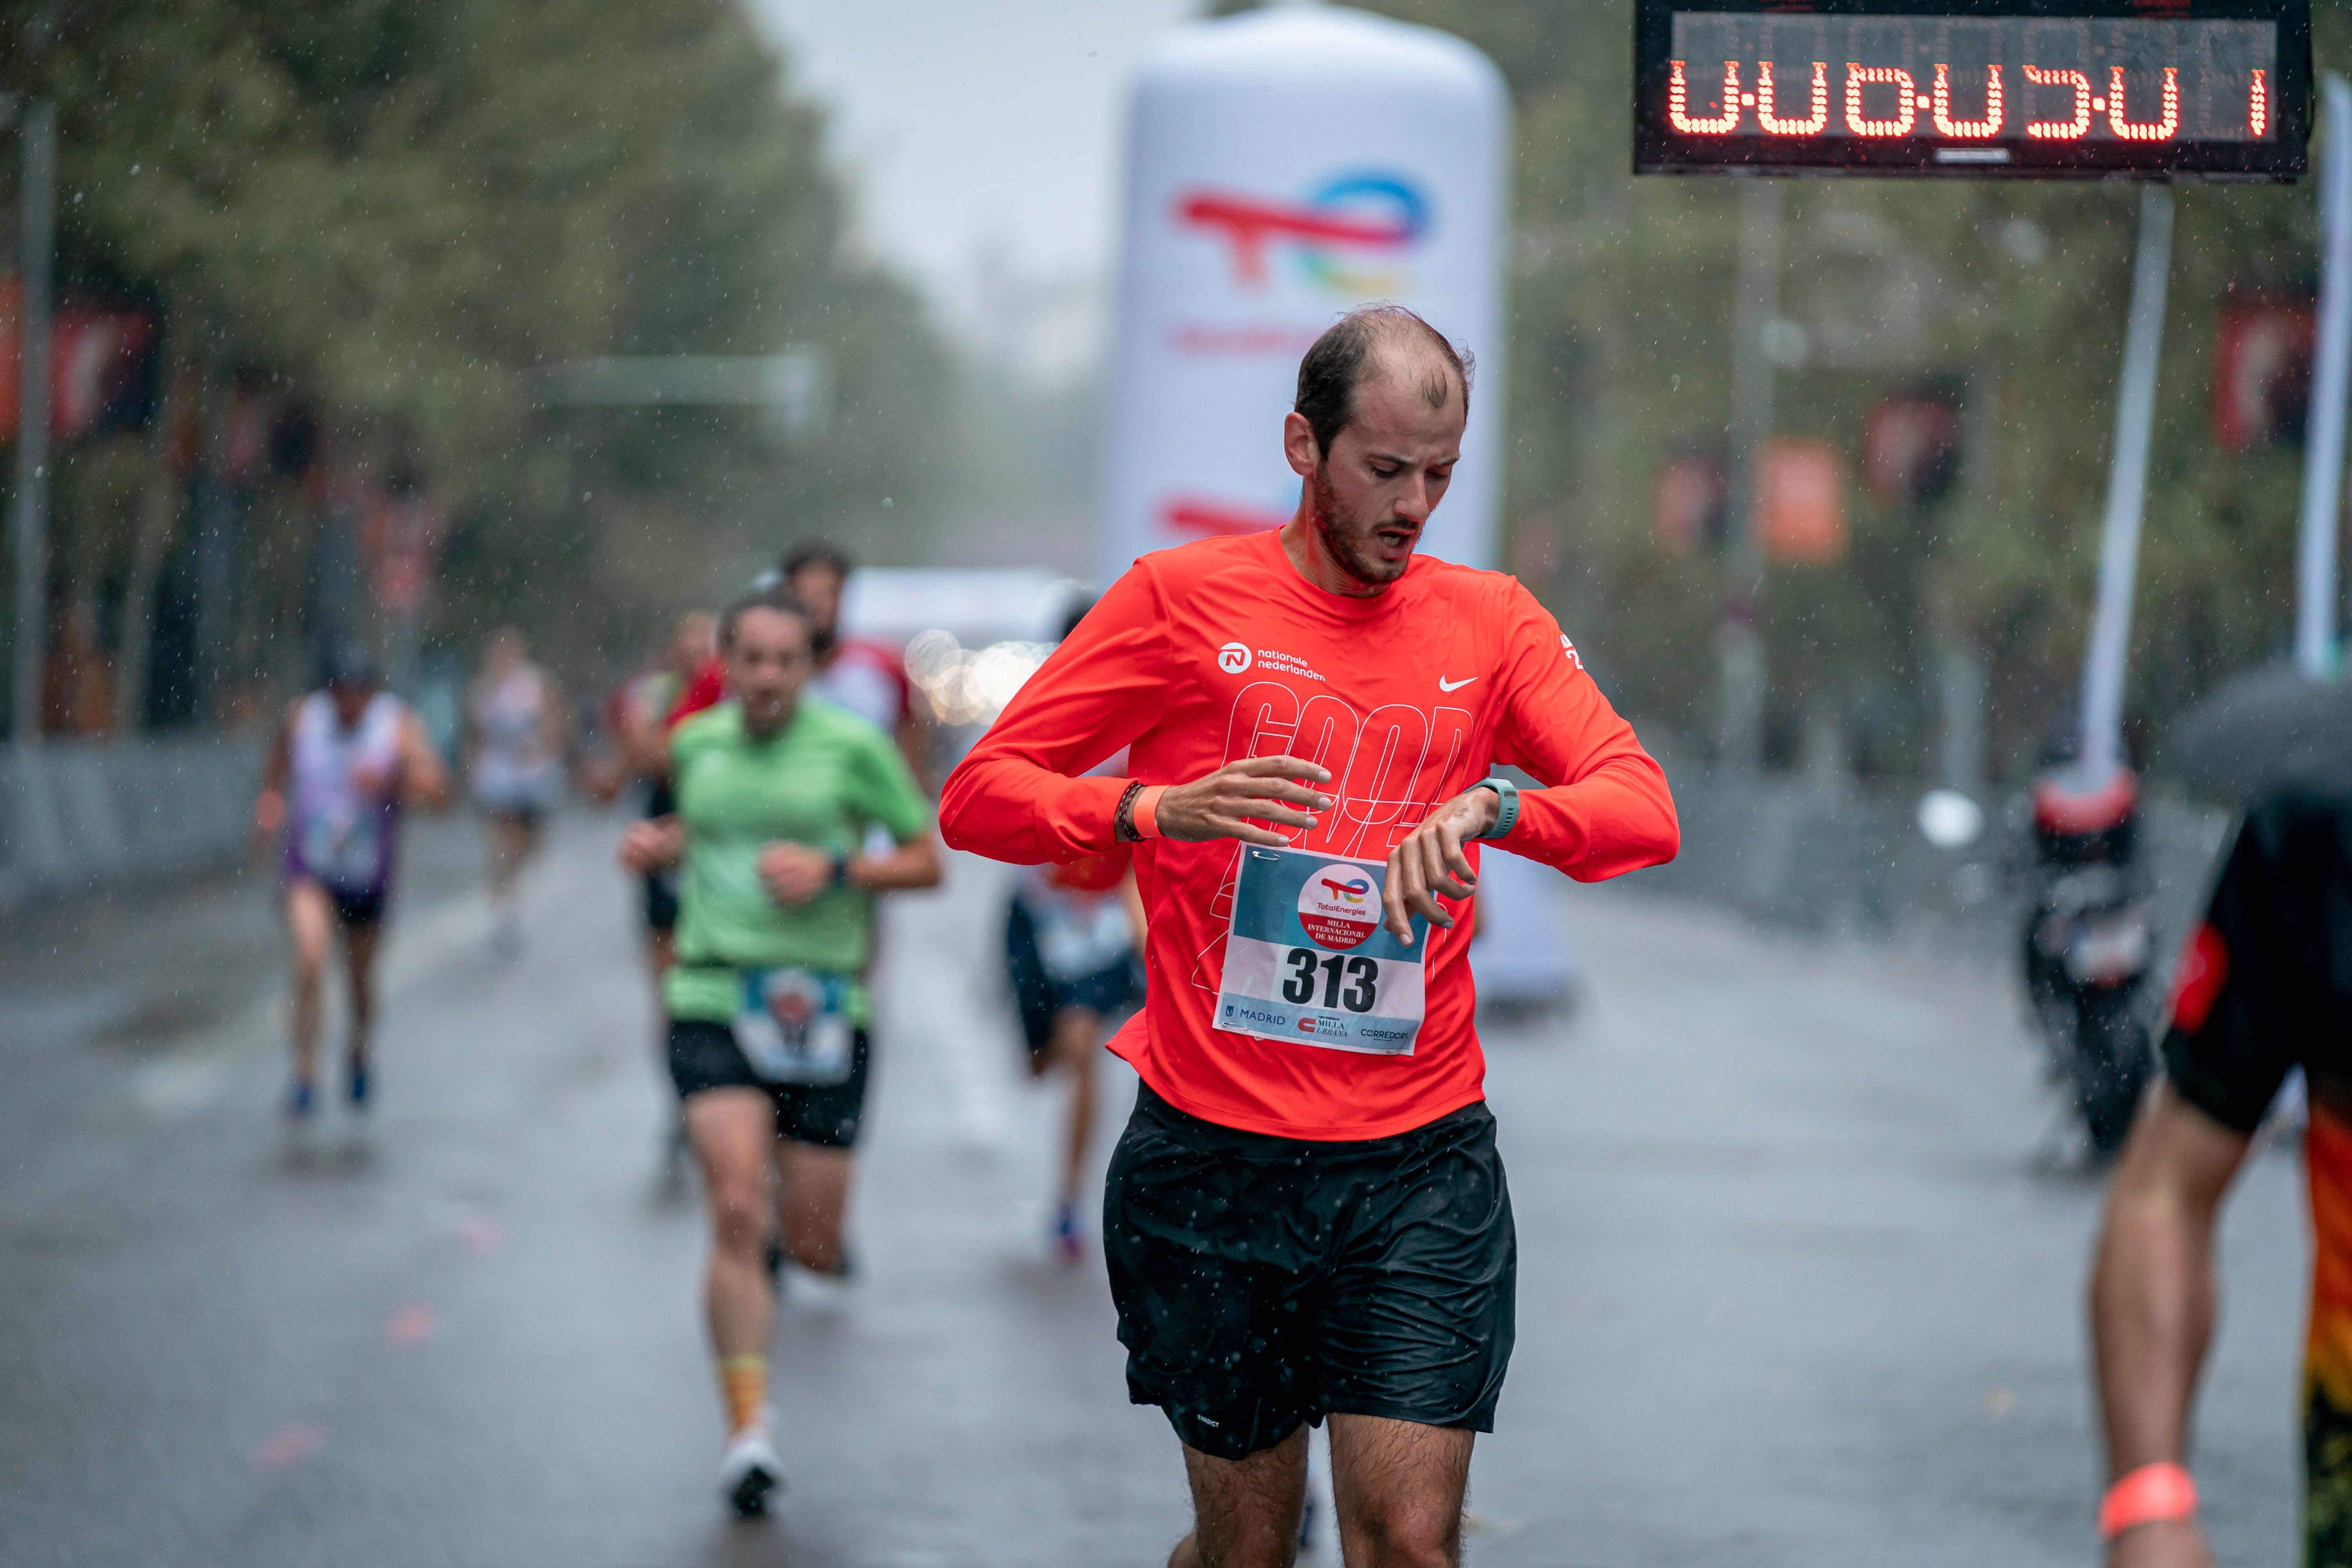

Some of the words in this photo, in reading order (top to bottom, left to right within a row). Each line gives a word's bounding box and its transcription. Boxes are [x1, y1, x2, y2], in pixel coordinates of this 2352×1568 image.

[1258, 649, 1308, 667] nationale
[1258, 660, 1326, 682] nederlanden
[1317, 902, 1366, 916] TotalEnergies
[1327, 919, 1350, 929] MILLA
[1327, 935, 1356, 944] MADRID
[1283, 948, 1379, 1013] 313
[1240, 1009, 1285, 1025] MADRID
[1318, 1020, 1344, 1029] MILLA
[1317, 1027, 1348, 1037] URBANA
[1198, 1414, 1220, 1428] EVADICT
